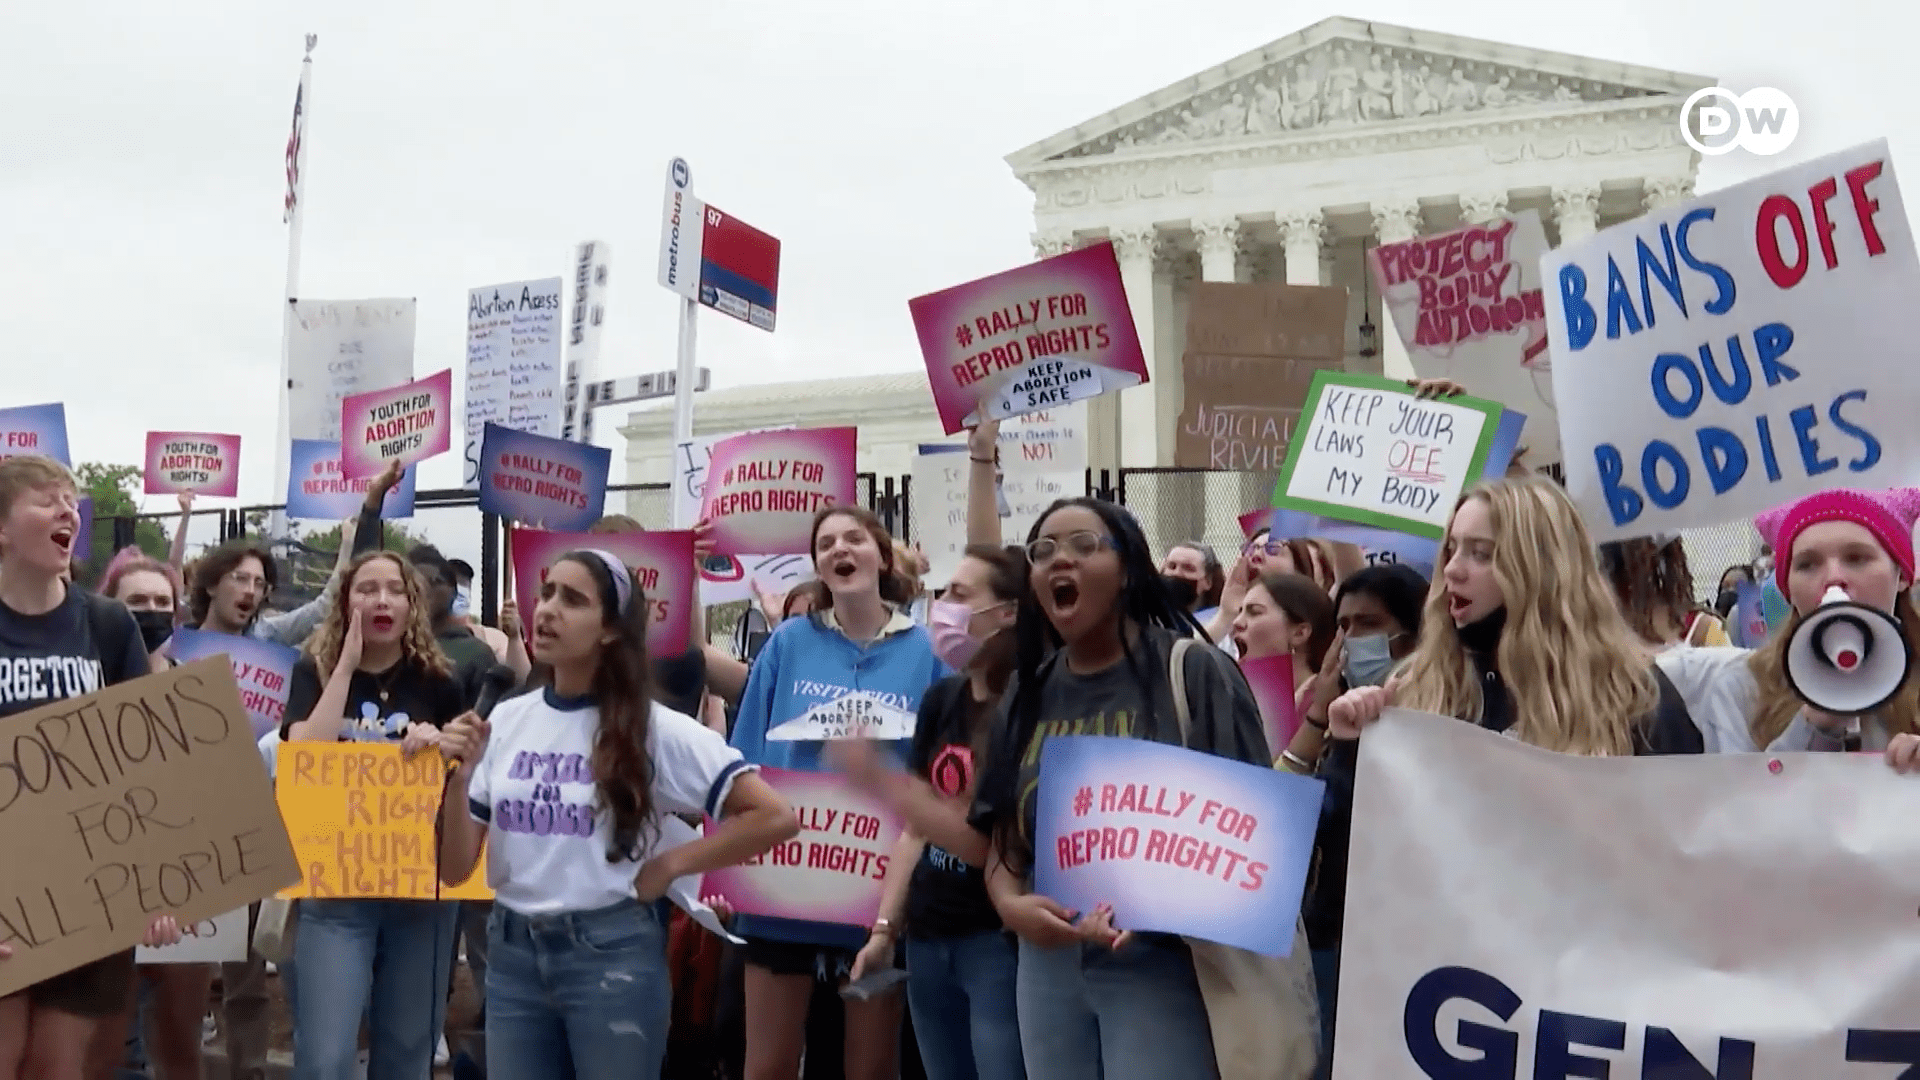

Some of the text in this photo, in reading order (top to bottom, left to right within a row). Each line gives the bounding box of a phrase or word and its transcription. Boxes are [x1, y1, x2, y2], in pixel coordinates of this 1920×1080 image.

[707, 209, 722, 228] 97
[667, 191, 683, 286] metrobus
[1376, 221, 1514, 286] PROTECT
[1558, 160, 1887, 351] BANS OFF
[1418, 262, 1512, 310] BODILY
[975, 299, 1041, 340] RALLY
[1047, 293, 1087, 320] FOR
[1415, 288, 1545, 346] AUTONOM
[951, 322, 1111, 388] REPRO RIGHTS
[1028, 361, 1063, 378] KEEP
[1651, 321, 1801, 419] OUR
[1012, 367, 1092, 394] ABORTION
[1027, 385, 1070, 407] SAFE
[366, 409, 436, 445] ABORTION
[370, 393, 431, 423] YOUTH FOR
[1323, 388, 1454, 445] KEEP YOUR
[8, 431, 38, 448] FOR
[165, 442, 218, 456] YOUTH FOR
[380, 433, 422, 458] RIGHTS!
[1210, 438, 1286, 471] REVIE
[1314, 426, 1443, 475] LAWS OFF
[1594, 389, 1882, 527] BODIES
[160, 455, 223, 471] ABORTION
[170, 471, 209, 483] RIGHTS!
[512, 454, 556, 476] RALLY
[556, 463, 583, 485] FOR
[737, 460, 788, 484] RALLY
[792, 462, 824, 484] FOR
[492, 472, 589, 510] REPRO RIGHTS
[711, 490, 763, 518] REPRO
[1326, 466, 1440, 515] MY BODY
[633, 567, 659, 591] OR
[0, 655, 106, 703] RGETOW
[253, 666, 285, 693] FOR
[792, 680, 915, 713] VISITION
[808, 713, 883, 726] ABORTION
[837, 699, 873, 714] KEEP
[294, 750, 440, 788] REPRODU
[67, 786, 195, 862] FOR
[348, 789, 437, 828] RIGH
[797, 806, 881, 841] LLY FOR
[1100, 783, 1196, 818] RALLY
[1198, 799, 1258, 843] FOR
[336, 830, 436, 868] HUM
[808, 842, 891, 881] RIGHTS
[1056, 826, 1269, 892] REPRO RIGHTS
[84, 828, 270, 933] PEOPLE
